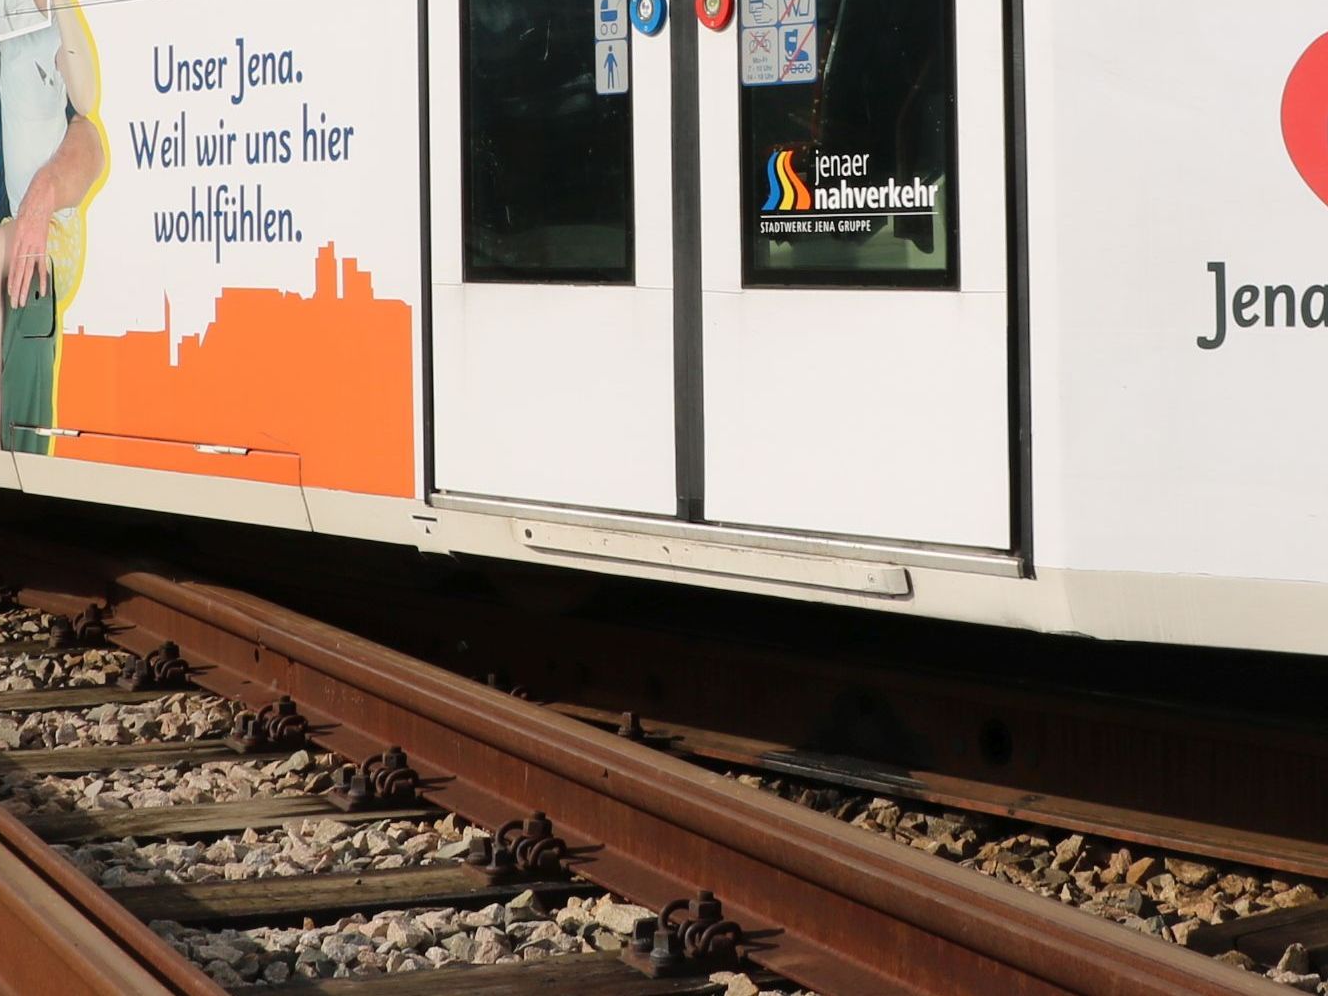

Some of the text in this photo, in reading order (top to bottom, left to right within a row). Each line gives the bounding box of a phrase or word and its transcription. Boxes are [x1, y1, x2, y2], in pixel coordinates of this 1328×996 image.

[154, 38, 304, 105] Unser Jena.
[129, 103, 354, 169] Weil wir uns hier
[814, 149, 870, 186] jenaer
[814, 177, 938, 210] nahverkehr
[153, 184, 303, 264] wohlfühlen.
[760, 219, 872, 234] STADTWERKE JENA GRUPPE
